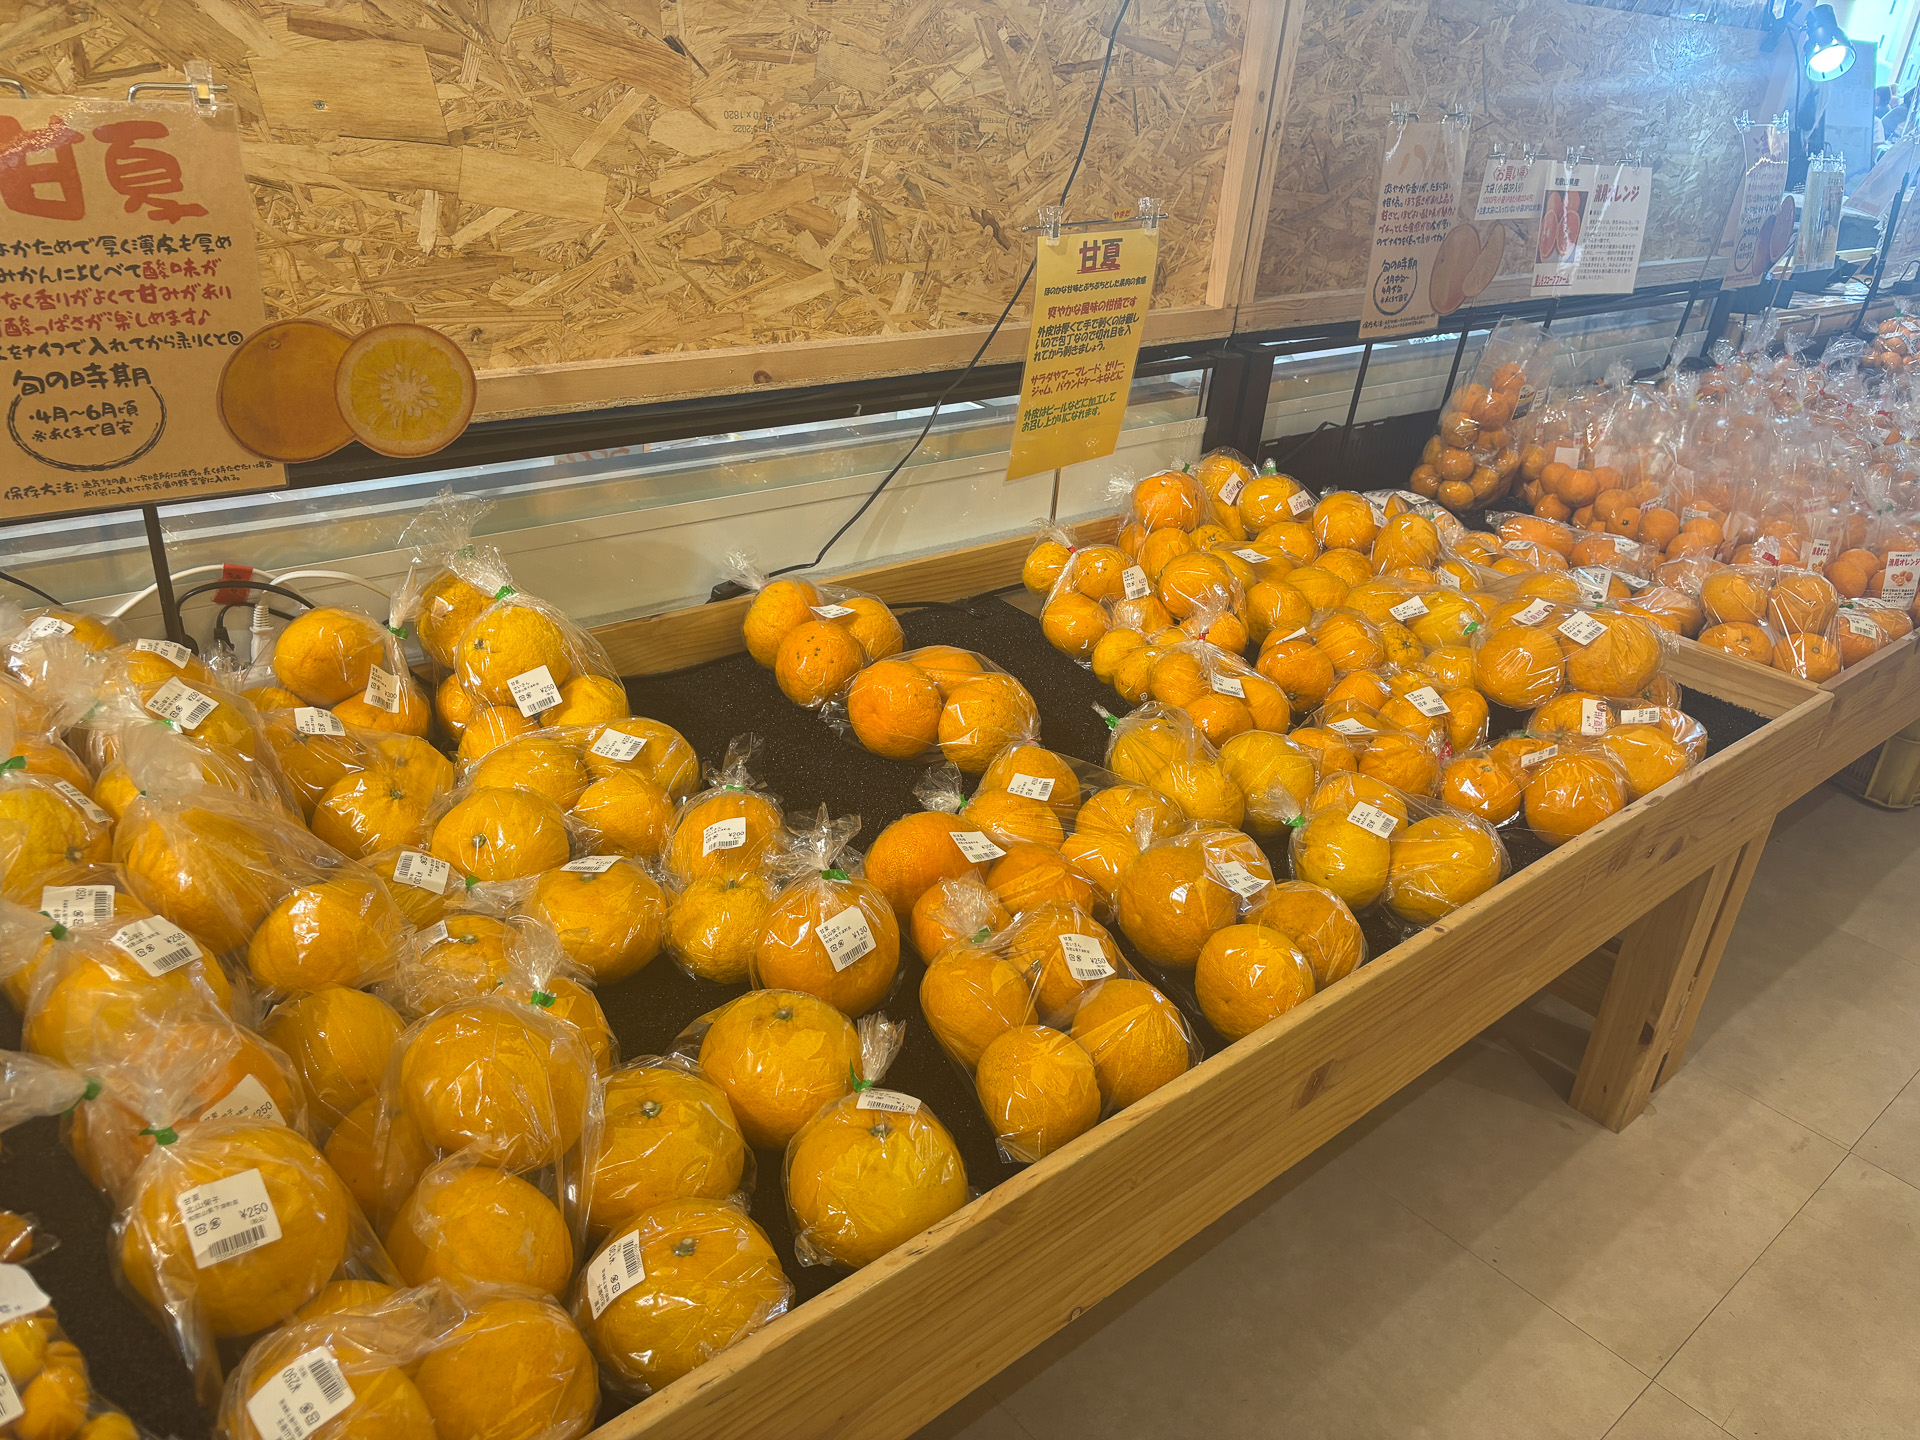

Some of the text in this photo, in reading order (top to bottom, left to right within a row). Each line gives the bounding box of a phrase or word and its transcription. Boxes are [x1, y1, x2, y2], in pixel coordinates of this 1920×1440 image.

[723, 111, 744, 119] 1820
[0, 114, 209, 224] 甘夏
[1079, 238, 1123, 272] 甘夏
[1382, 257, 1417, 272] 旬の時期
[1048, 296, 1137, 319] 爽やかな風味の柑橘です
[1037, 313, 1140, 338] 外皮は厚くて手で剥くのは難し
[1035, 325, 1132, 350] いので包丁なので切れ目を入
[1033, 341, 1105, 362] れてから剥きましょう。
[13, 362, 151, 396] 旬の時期
[1031, 360, 1126, 386] サラダやマーマレード、ゼリー、
[1031, 370, 1125, 397] ジャム、パウンドケーキなどに
[1024, 392, 1117, 421] 外皮はピールなどに加工して
[1021, 407, 1101, 432] お召し上がりになれます。
[31, 419, 134, 443] ※あくまで目安
[186, 691, 200, 702] ¥250
[540, 683, 555, 693] ¥250
[413, 871, 422, 885] ¥130
[116, 931, 128, 942] 甘夏
[166, 932, 185, 945] ¥250
[819, 926, 829, 934] 甘夏
[851, 925, 868, 939] ¥130
[183, 1192, 200, 1205] 甘夏
[239, 1202, 269, 1220] ¥250
[282, 1368, 303, 1393] ¥250
